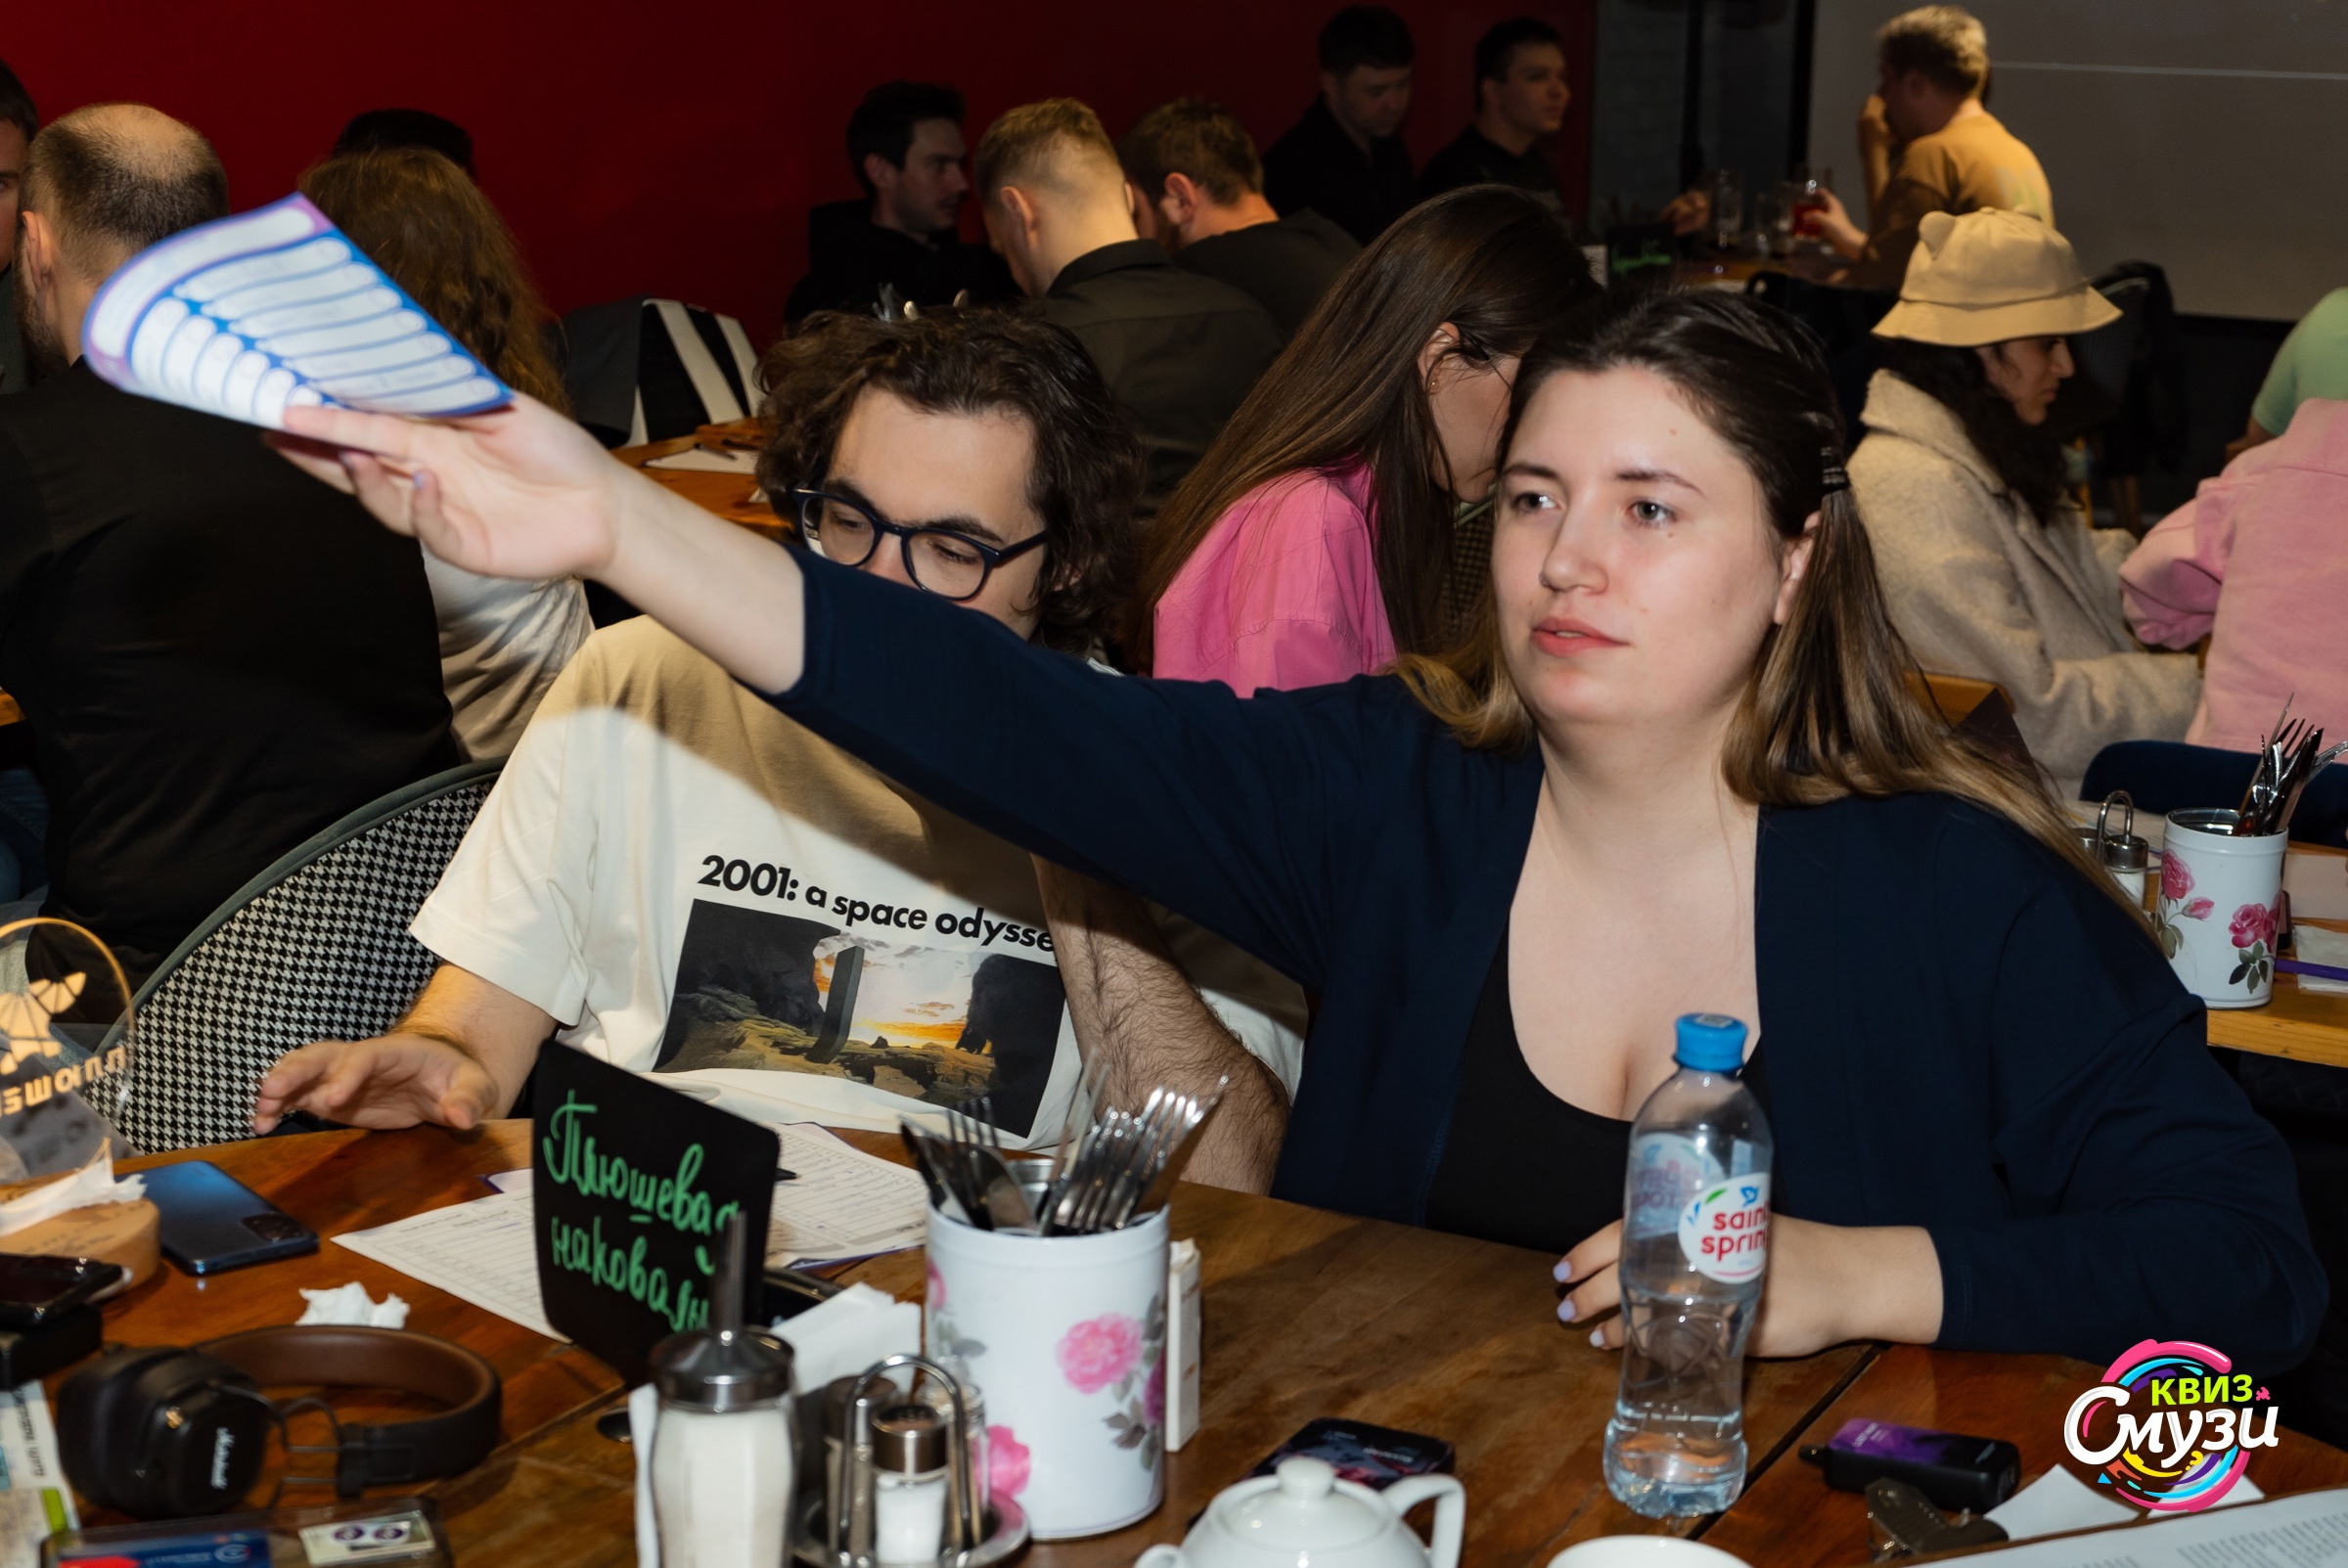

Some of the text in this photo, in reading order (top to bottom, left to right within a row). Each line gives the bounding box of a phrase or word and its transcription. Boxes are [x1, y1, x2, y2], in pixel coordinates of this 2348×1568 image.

[697, 854, 1056, 953] 2001: a space odysse
[0, 1045, 127, 1116] swann
[1713, 1202, 1769, 1231] sain
[1700, 1229, 1767, 1262] sprin
